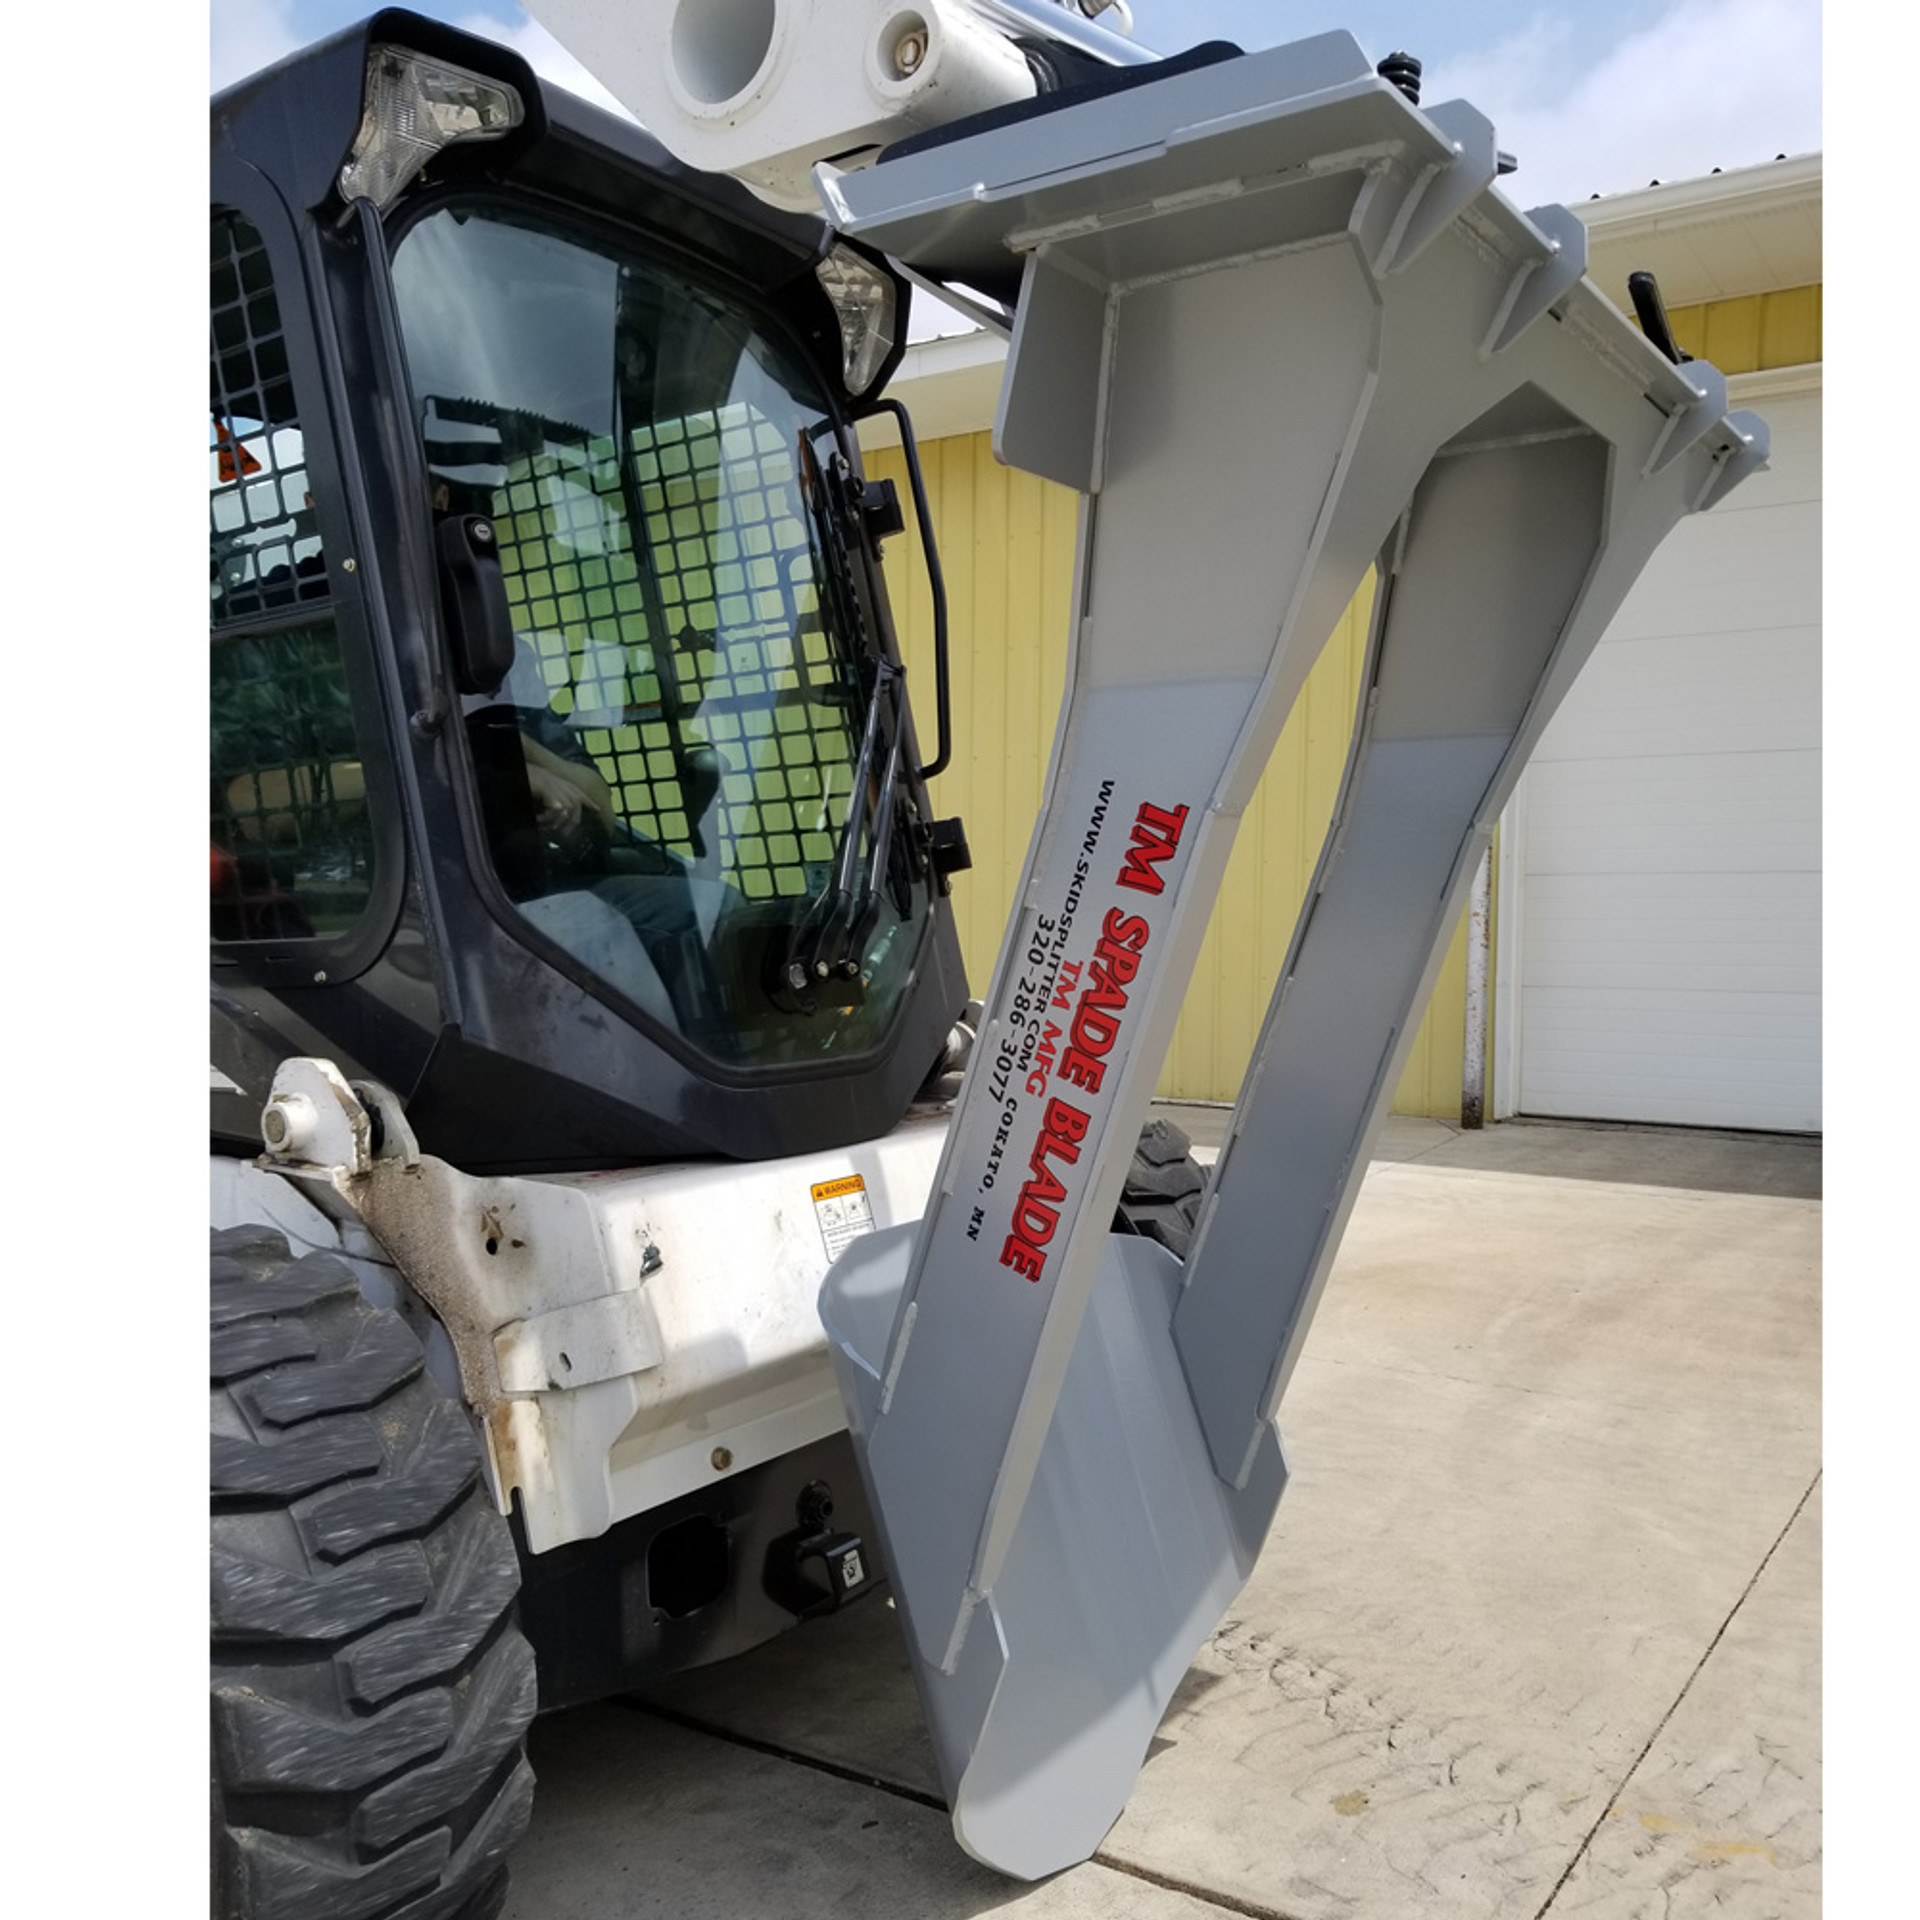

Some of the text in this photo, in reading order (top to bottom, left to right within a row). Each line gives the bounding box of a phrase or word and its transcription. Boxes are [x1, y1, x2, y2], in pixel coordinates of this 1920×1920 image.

[988, 914, 1055, 1103] 320-286-3077
[999, 801, 1190, 1283] TM SPADE BLADE
[1025, 960, 1084, 1098] TM MFG
[824, 1179, 861, 1195] WARNING
[965, 1097, 1018, 1242] COKATO, MN
